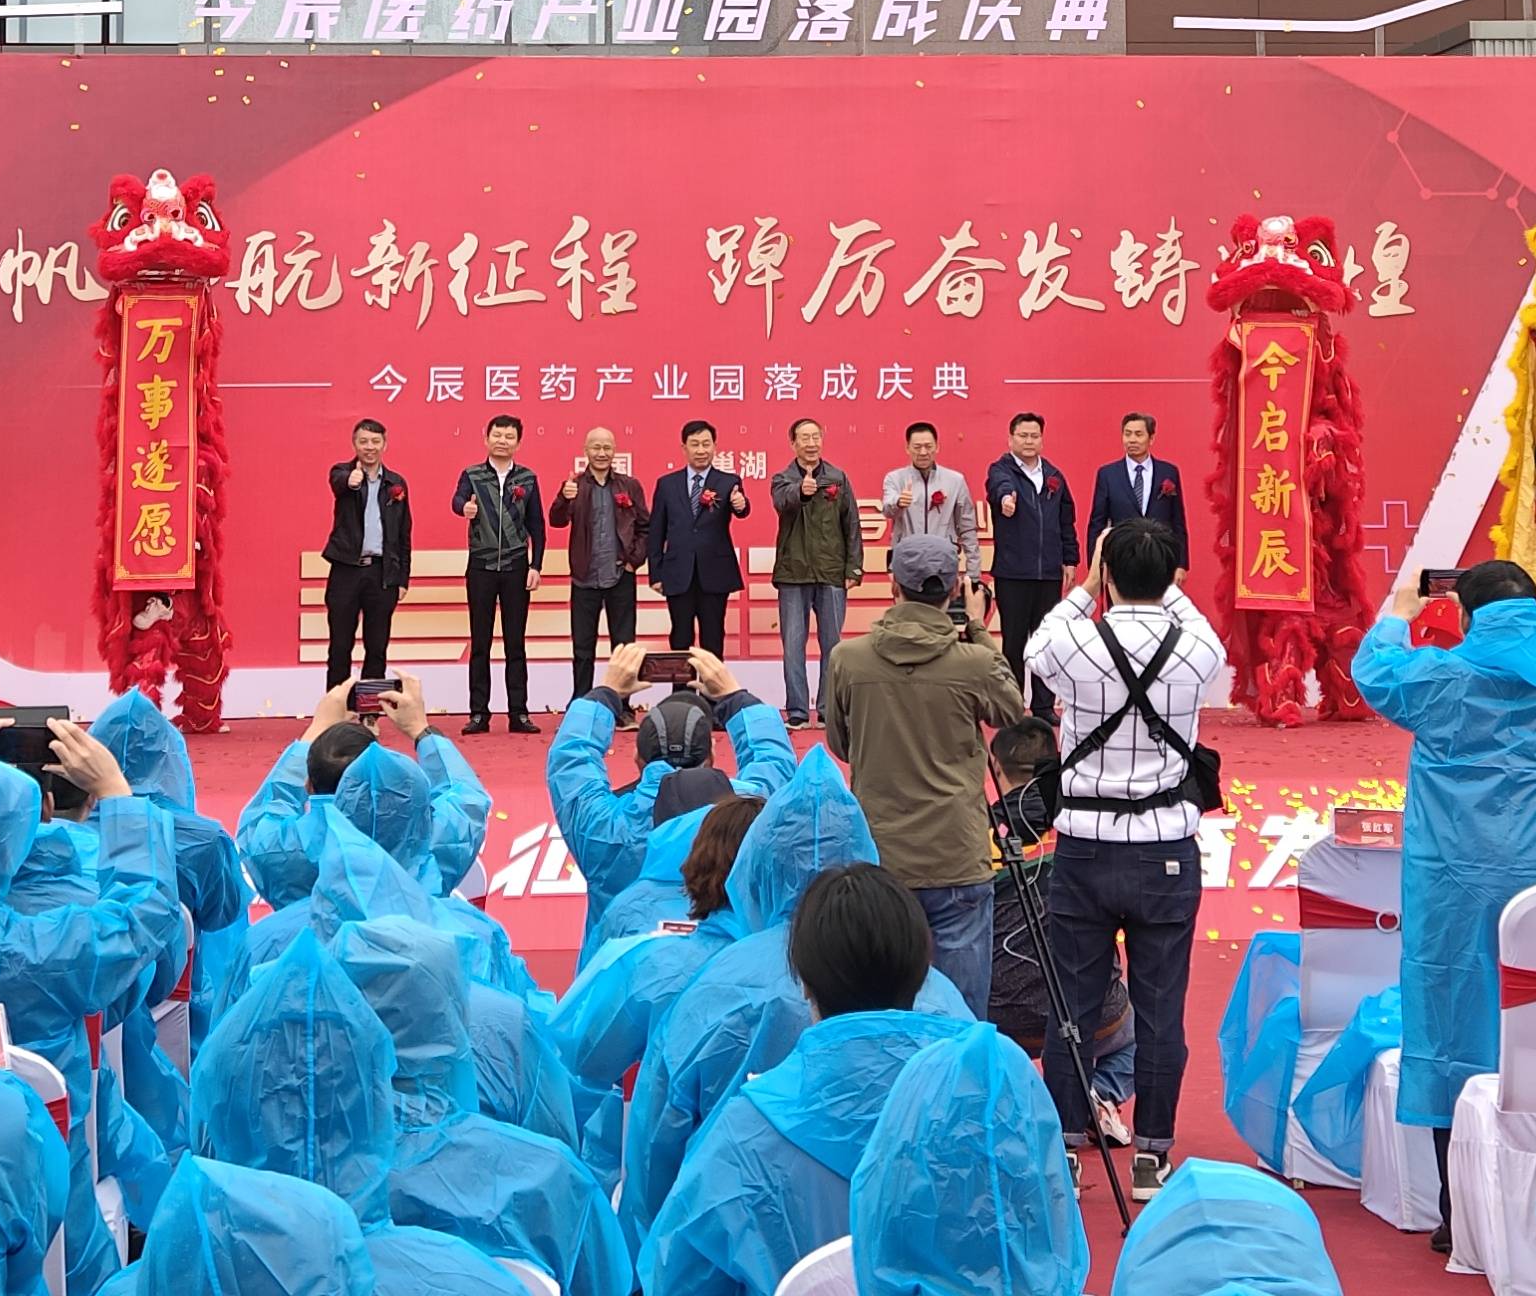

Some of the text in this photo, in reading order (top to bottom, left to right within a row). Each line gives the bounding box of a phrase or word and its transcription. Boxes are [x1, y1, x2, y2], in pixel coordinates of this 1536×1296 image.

[705, 215, 1416, 341] 踔厉奋发铸煌
[128, 316, 183, 557] 万事遂愿
[368, 361, 970, 403] 今辰医药产业园落成庆典
[1248, 340, 1301, 579] 今启新辰
